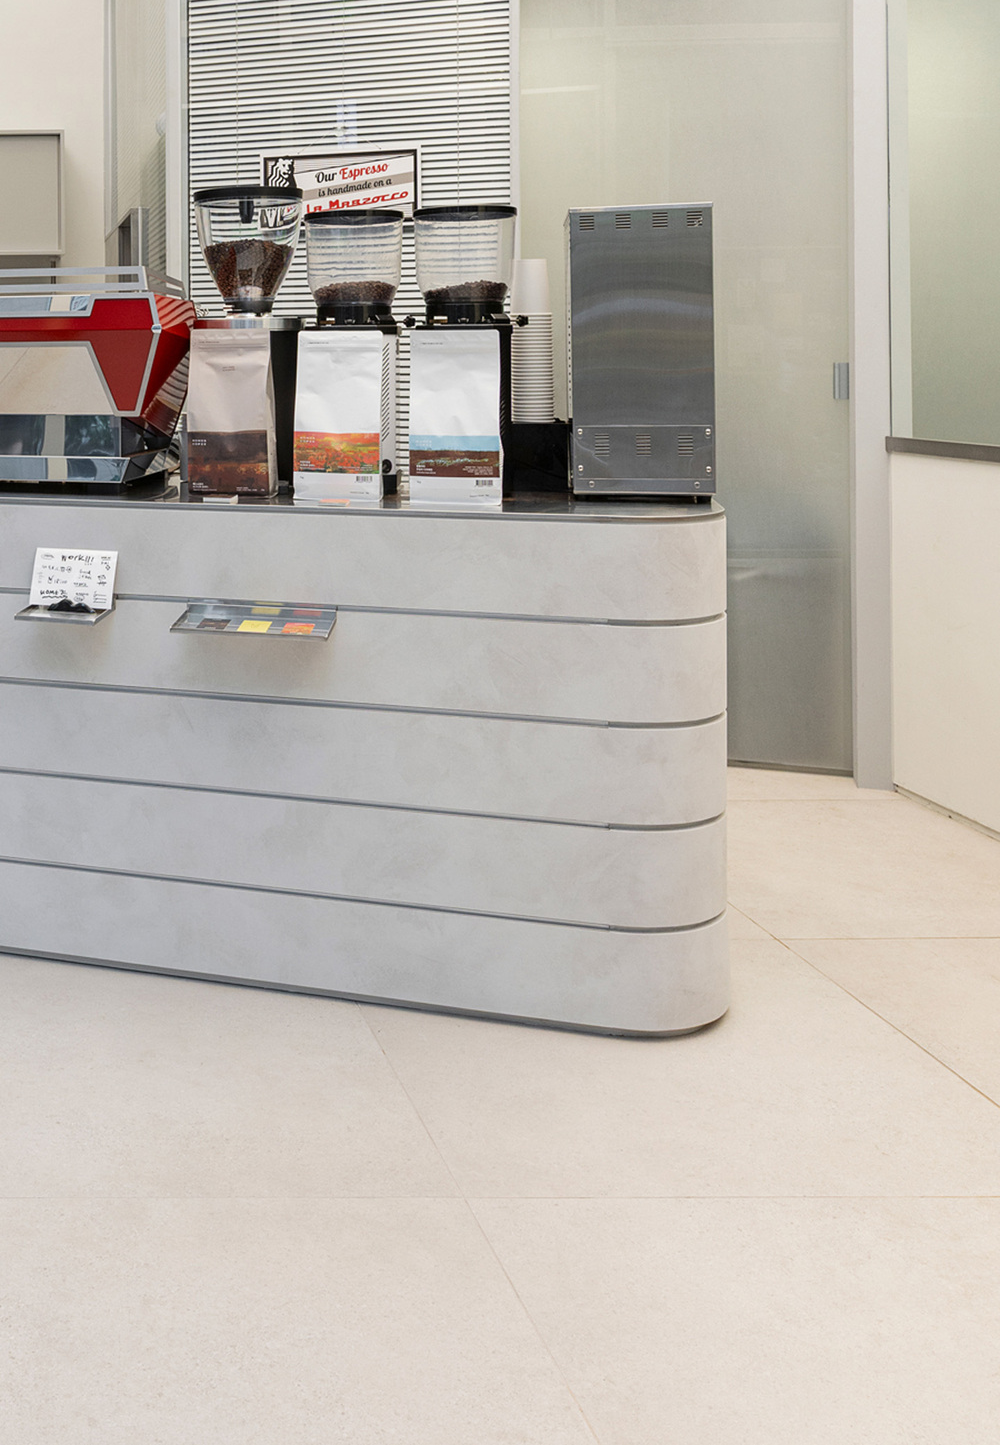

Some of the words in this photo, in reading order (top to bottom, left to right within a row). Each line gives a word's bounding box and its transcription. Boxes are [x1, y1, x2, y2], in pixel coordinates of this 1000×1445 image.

[315, 171, 337, 184] Our
[339, 163, 389, 181] Espresso
[318, 189, 326, 198] is
[327, 181, 372, 196] handmade
[373, 179, 385, 189] on
[385, 178, 393, 186] a
